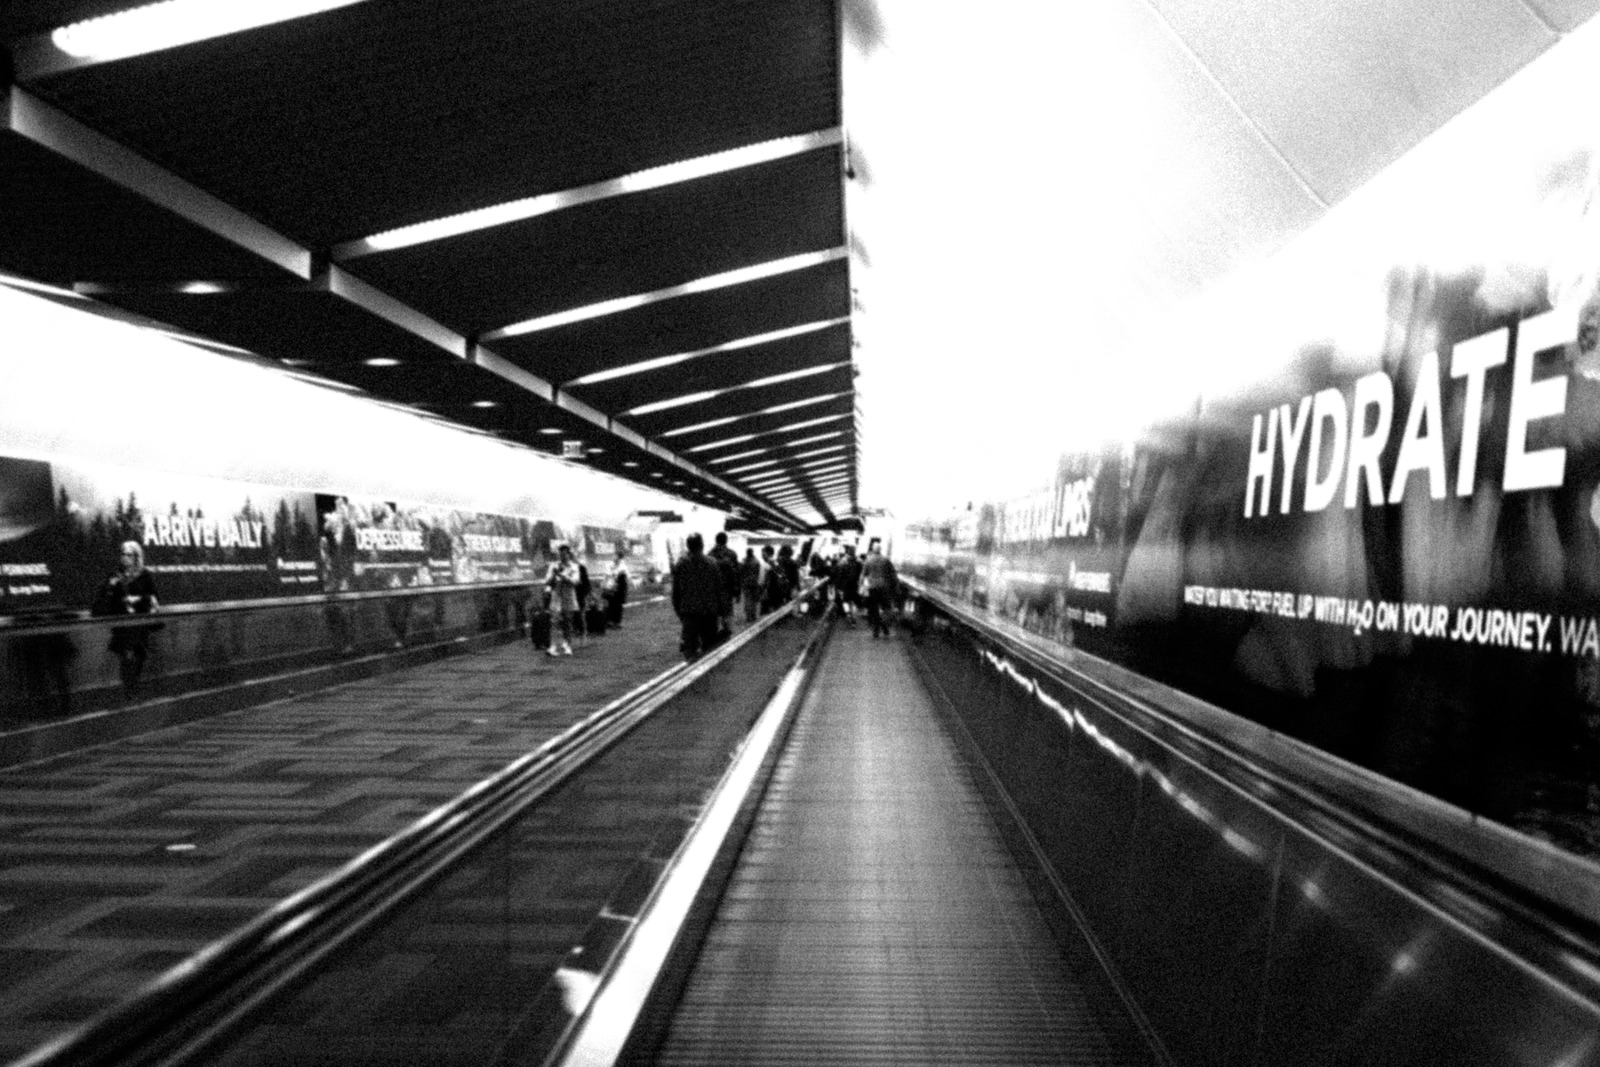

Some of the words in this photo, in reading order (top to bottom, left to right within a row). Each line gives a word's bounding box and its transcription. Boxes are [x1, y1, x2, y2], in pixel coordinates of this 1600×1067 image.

[1244, 297, 1578, 518] HYDRATE
[144, 514, 215, 547] ARRIVE
[217, 517, 263, 548] DAILY
[1273, 591, 1296, 617] FUEL
[1297, 594, 1314, 618] UP
[1314, 596, 1346, 624] WITH
[1375, 600, 1400, 631] ON
[1402, 602, 1449, 638] YOUR
[1450, 606, 1552, 652] JOURNEY.
